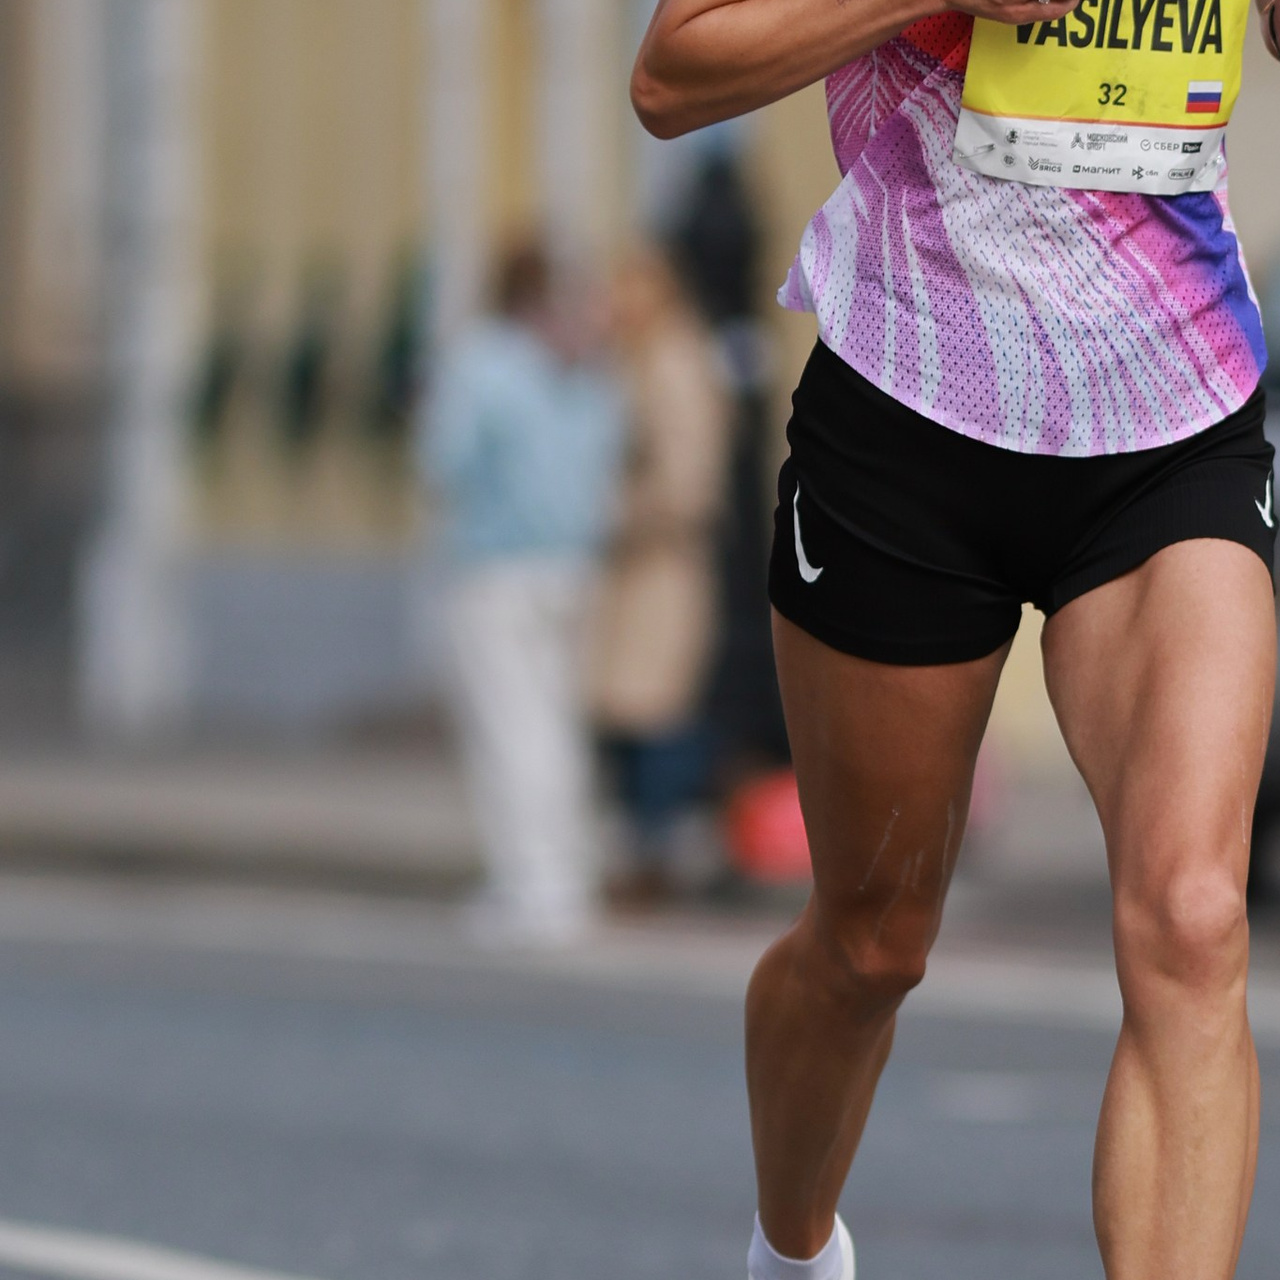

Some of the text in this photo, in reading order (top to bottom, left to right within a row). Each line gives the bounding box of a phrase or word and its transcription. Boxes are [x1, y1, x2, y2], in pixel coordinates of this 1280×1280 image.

[1097, 82, 1128, 106] 32
[1153, 141, 1180, 152] СБЕР
[1039, 164, 1062, 173] BRICS
